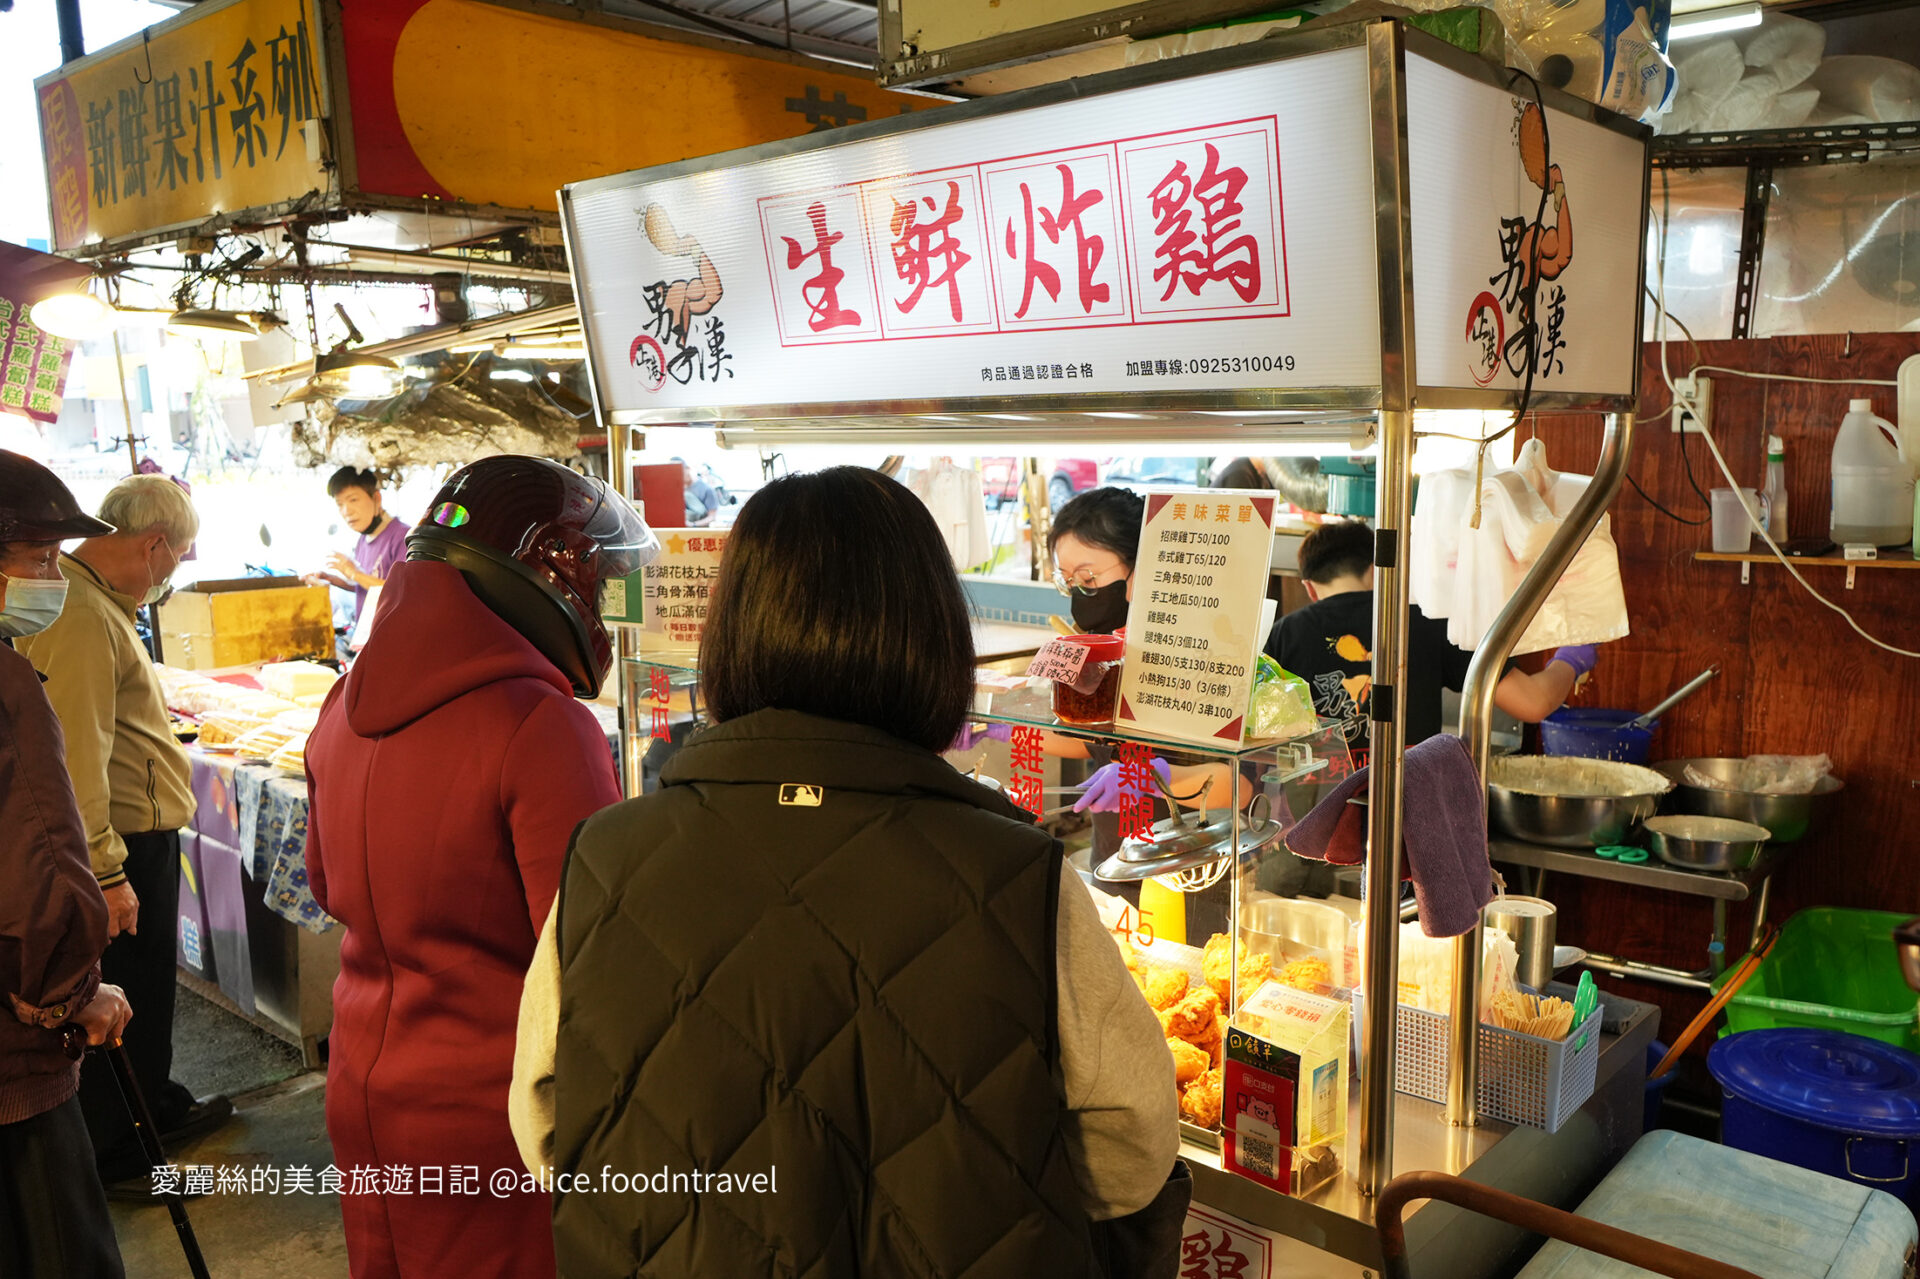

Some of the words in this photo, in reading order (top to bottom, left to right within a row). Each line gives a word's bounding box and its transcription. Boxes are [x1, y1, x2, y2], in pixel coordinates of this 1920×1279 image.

[86, 20, 314, 210] 新鮮果汁系列
[42, 84, 85, 243] 現榨
[642, 280, 734, 385] 男子漢
[981, 362, 1094, 382] 肉品通過認證合格
[1126, 355, 1296, 377] 加盟專線:0925310049
[1173, 503, 1254, 524] 美味菜單
[1160, 530, 1231, 547] 招牌雞丁50/100
[1157, 550, 1227, 567] 泰式雞丁65/120
[645, 585, 714, 599] 三角骨滿佰
[1153, 571, 1213, 587] 三角骨50/100
[1150, 590, 1220, 609] 手工地瓜50/100
[1147, 610, 1178, 626] 雞腿45
[1144, 630, 1209, 651] 腿塊45/3個120
[1141, 651, 1245, 678] 雞翅30/5支130/8支200
[649, 667, 672, 743] 地瓜
[1313, 670, 1371, 743] 男子
[1010, 725, 1045, 823] 雞翅
[1118, 741, 1156, 844] 雞腿
[1115, 905, 1155, 948] 45
